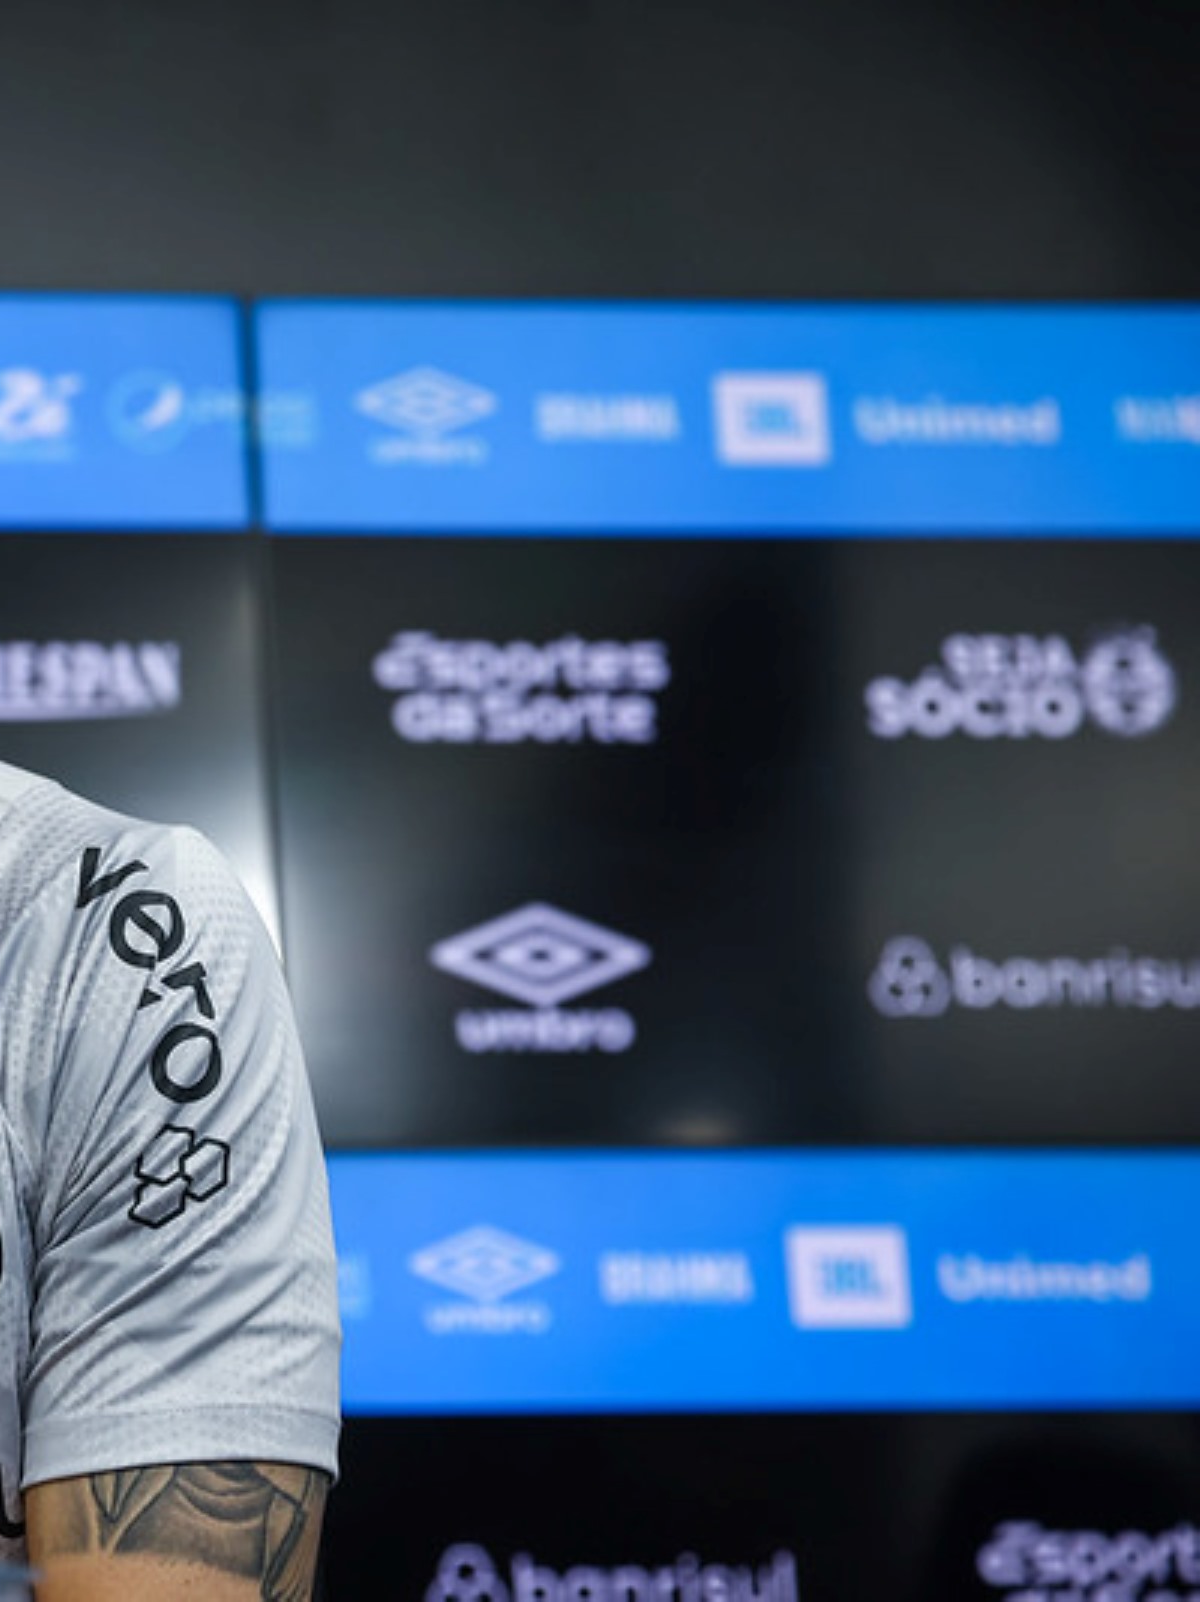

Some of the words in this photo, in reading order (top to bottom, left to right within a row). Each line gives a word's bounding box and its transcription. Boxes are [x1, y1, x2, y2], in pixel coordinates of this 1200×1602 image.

[76, 847, 222, 1103] vero
[455, 1006, 637, 1053] umbro
[936, 1252, 1151, 1303] Unimed
